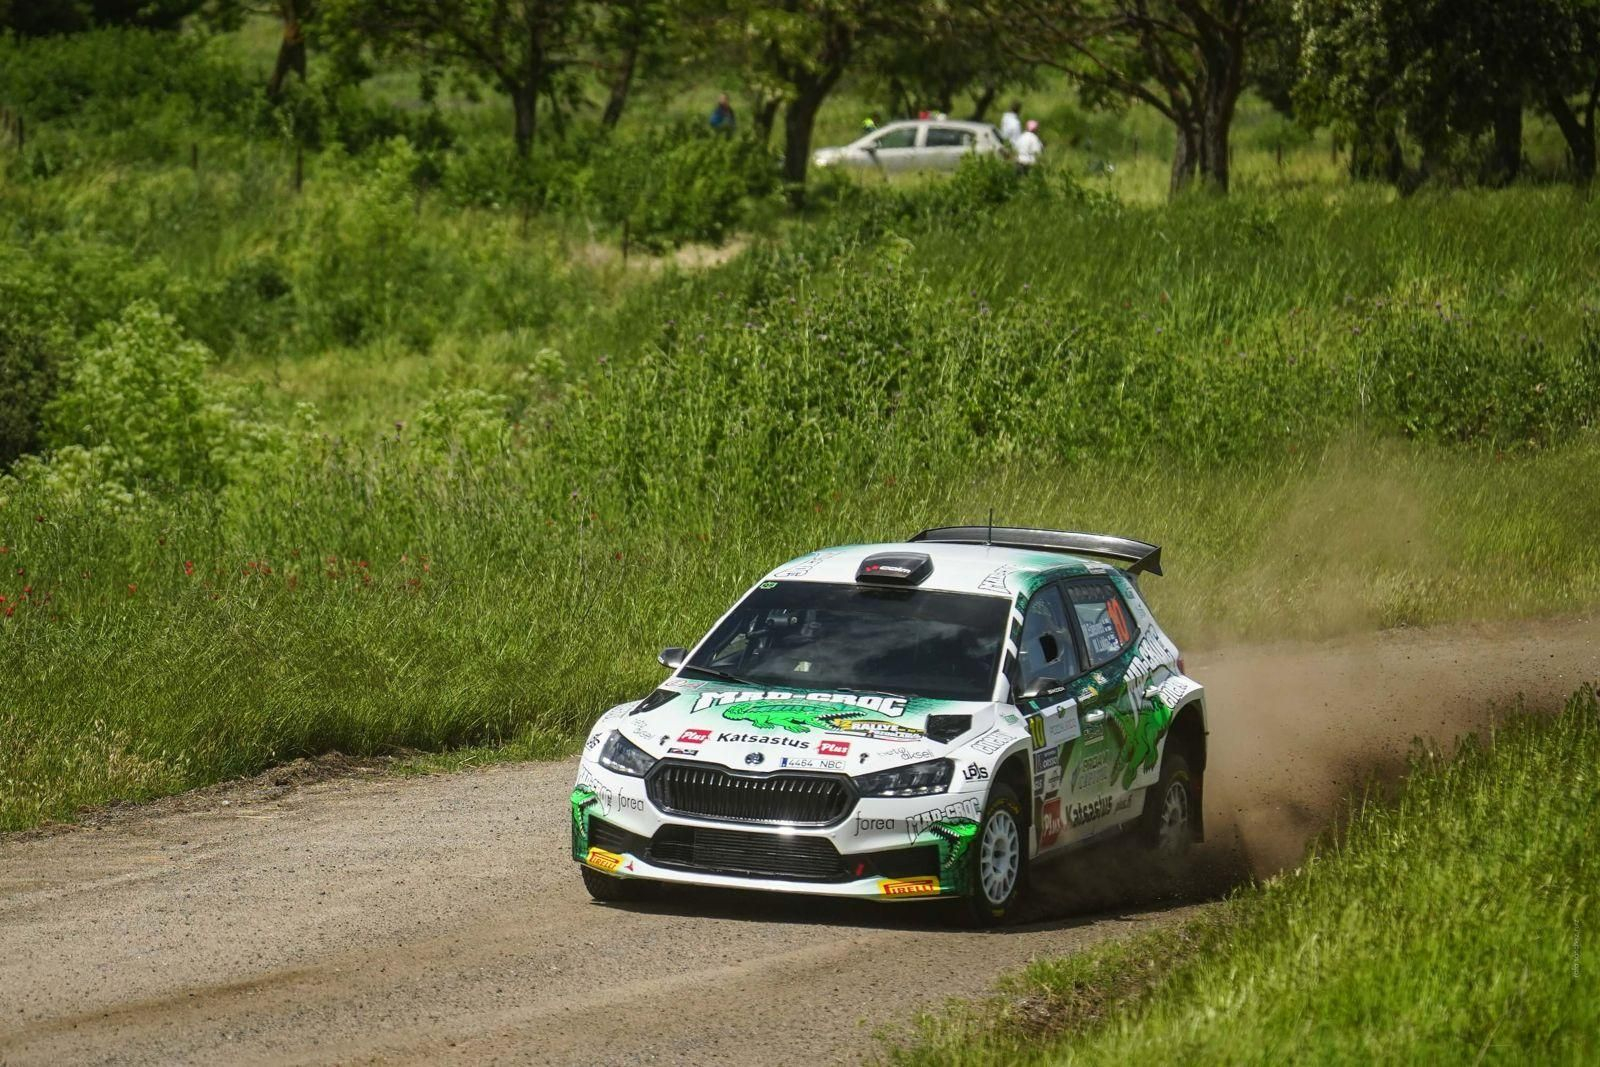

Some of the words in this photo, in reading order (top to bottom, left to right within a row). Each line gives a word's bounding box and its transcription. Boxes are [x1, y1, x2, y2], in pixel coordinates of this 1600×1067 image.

[690, 691, 908, 718] MAD-CROC
[682, 731, 709, 742] Plus
[717, 732, 811, 750] Katsastus
[820, 743, 849, 753] Plus
[1029, 716, 1047, 749] 10
[820, 760, 843, 769] NBC
[617, 787, 644, 812] forea
[1065, 795, 1113, 828] Katsastus
[853, 811, 895, 836] forea
[905, 797, 982, 845] MAD-CROC
[588, 852, 620, 870] PIRELLI
[883, 880, 934, 896] PIRELLI
